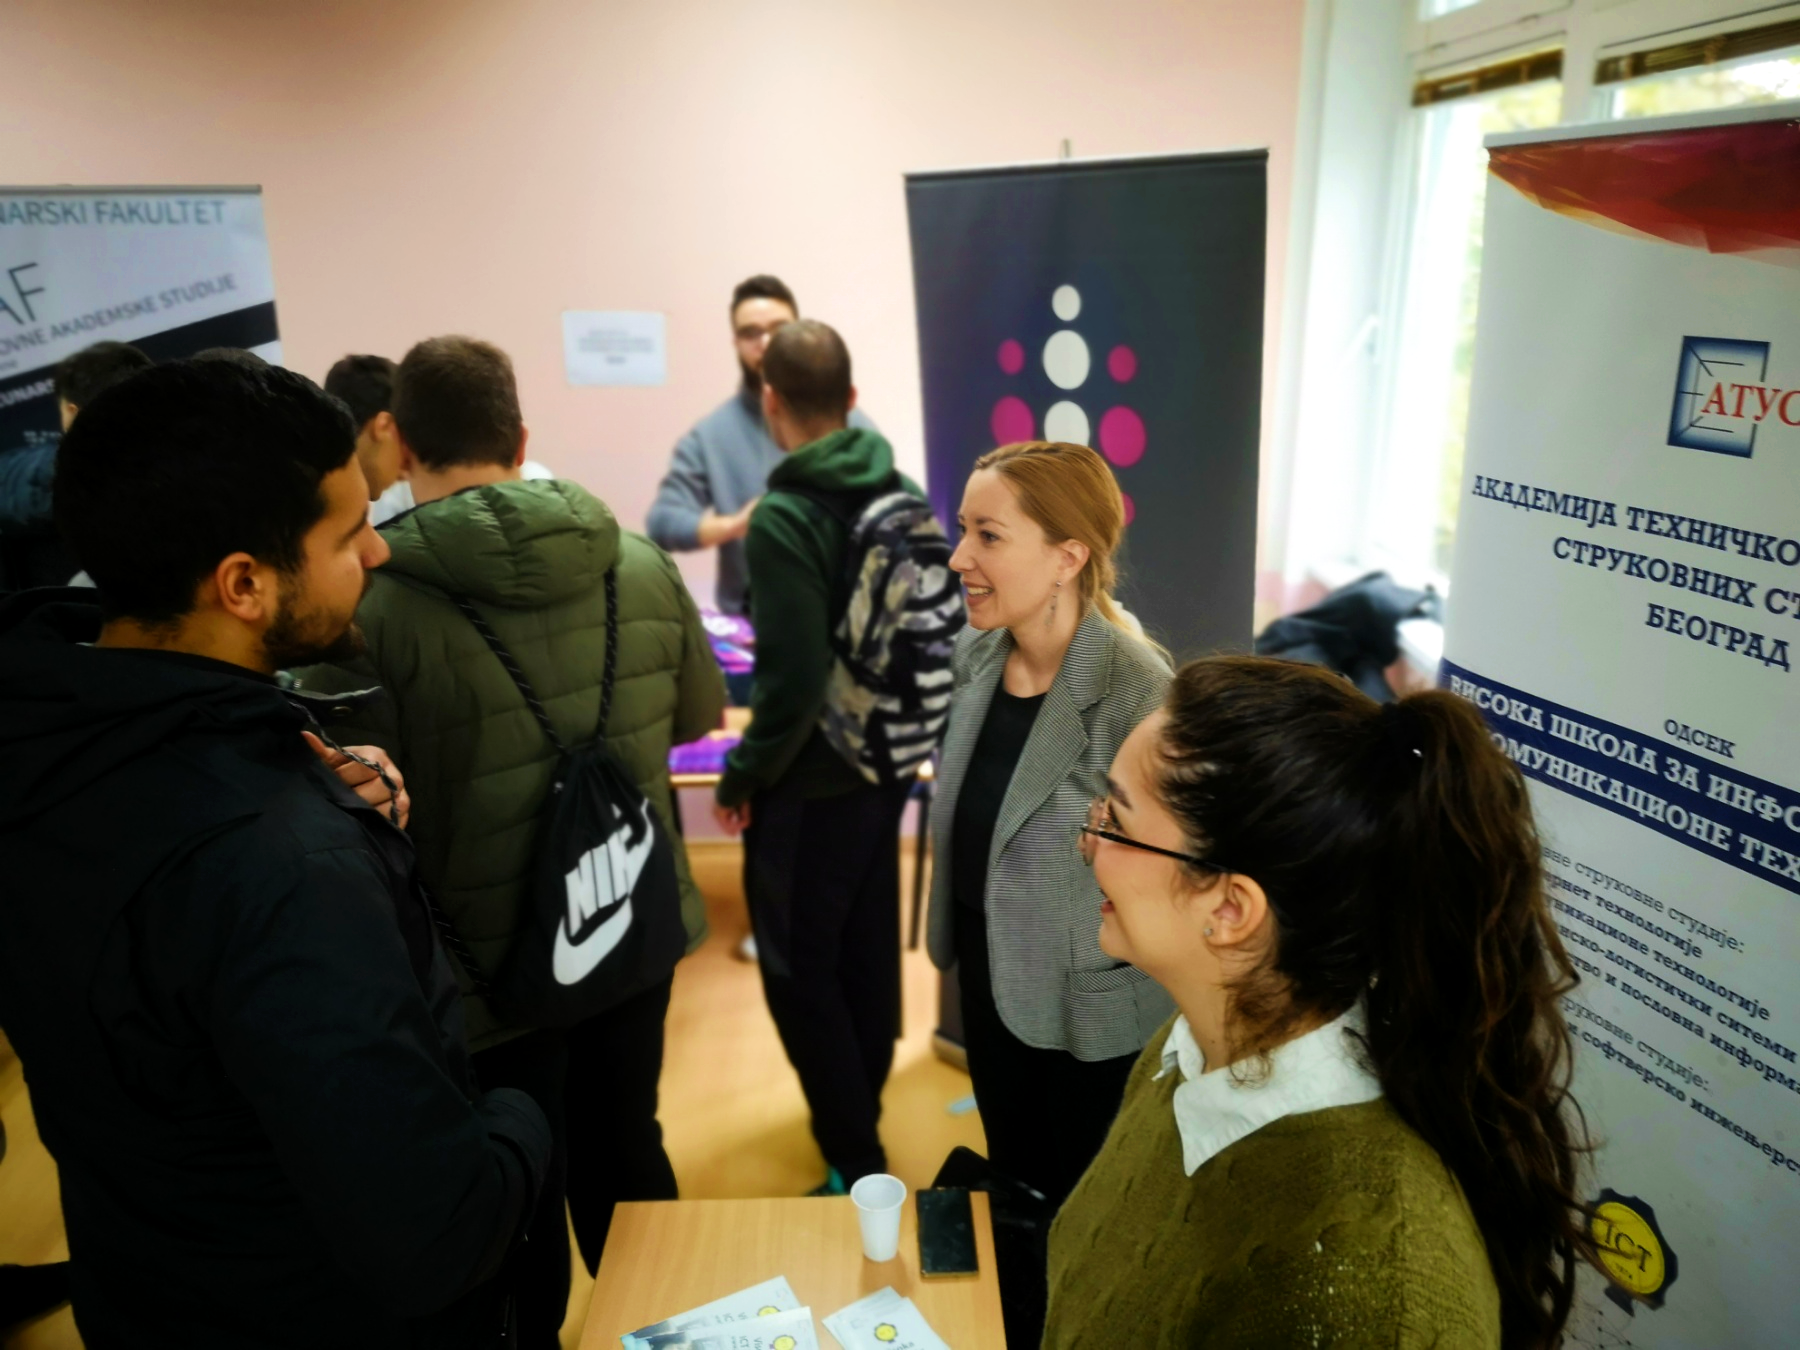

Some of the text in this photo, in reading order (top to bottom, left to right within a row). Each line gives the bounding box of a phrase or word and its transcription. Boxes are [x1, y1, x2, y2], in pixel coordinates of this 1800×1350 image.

[94, 199, 226, 225] FAKULTET
[50, 296, 158, 340] AKADEMSKE
[158, 273, 237, 308] STUDIJE
[1472, 474, 1800, 566] АКАДЕМИЈА ТЕХНИЧКО
[1553, 536, 1757, 608] СТРУКОВНИХ
[1645, 602, 1791, 673] БЕОГРАД
[1451, 674, 1545, 731] ВИСОКА
[1548, 713, 1659, 775] ШКОЛА
[1663, 756, 1701, 793] ЗА
[1664, 719, 1736, 760] ОДСЕК
[1490, 732, 1733, 852] ОМУНИКАЦИОНЕ
[1575, 862, 1664, 913] струковне
[1550, 896, 1771, 1021] никационе технологије
[1594, 895, 1703, 959] технологије
[1558, 925, 1713, 1017] нско-логистички
[1604, 971, 1617, 988] и
[1620, 981, 1705, 1039] пословна
[1582, 1031, 1687, 1102] софтверско
[1690, 1096, 1800, 1177] инжењерс
[1605, 1222, 1652, 1272] ICT
